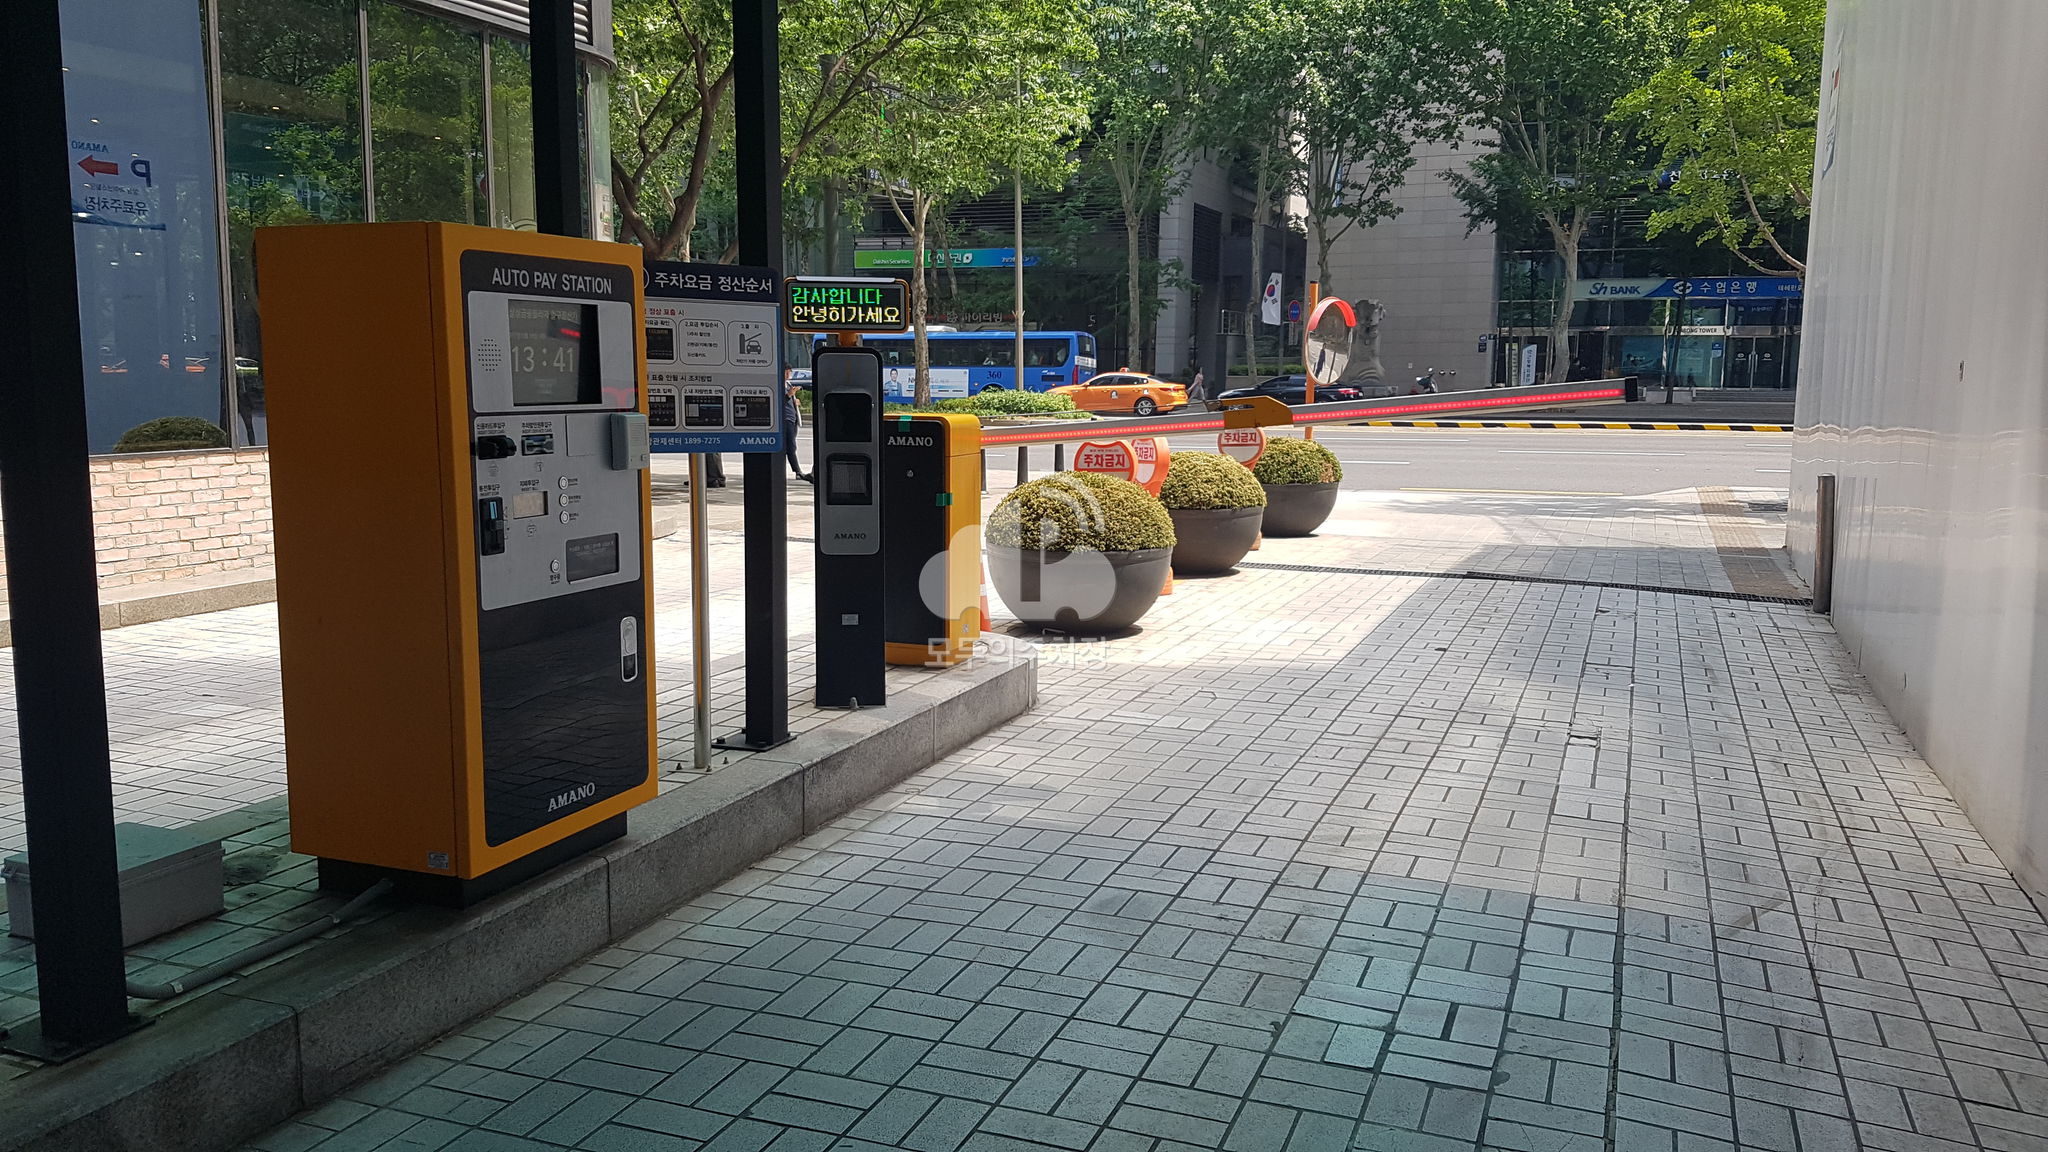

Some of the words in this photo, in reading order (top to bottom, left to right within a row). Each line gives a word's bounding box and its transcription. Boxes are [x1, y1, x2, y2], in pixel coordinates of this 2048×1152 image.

[492, 267, 530, 287] AUTO
[533, 271, 558, 290] PAY
[562, 273, 612, 295] STATION
[654, 272, 713, 291] 주차요금
[718, 276, 773, 294] 정산순서
[1700, 281, 1758, 294] 수협은행
[792, 287, 883, 305] 감사합니다
[1589, 282, 1608, 296] Sh
[1610, 286, 1641, 295] BANK
[792, 305, 901, 324] 안녕히가세요
[511, 346, 575, 373] 13:41
[987, 370, 1002, 379] 360
[684, 436, 721, 445] 1899-7275
[739, 436, 776, 446] AMANO
[887, 436, 934, 447] AMANO
[1222, 432, 1257, 443] 주차금지
[1084, 453, 1126, 468] 주차금지
[834, 532, 867, 540] AMANO
[547, 781, 596, 813] AMANO
